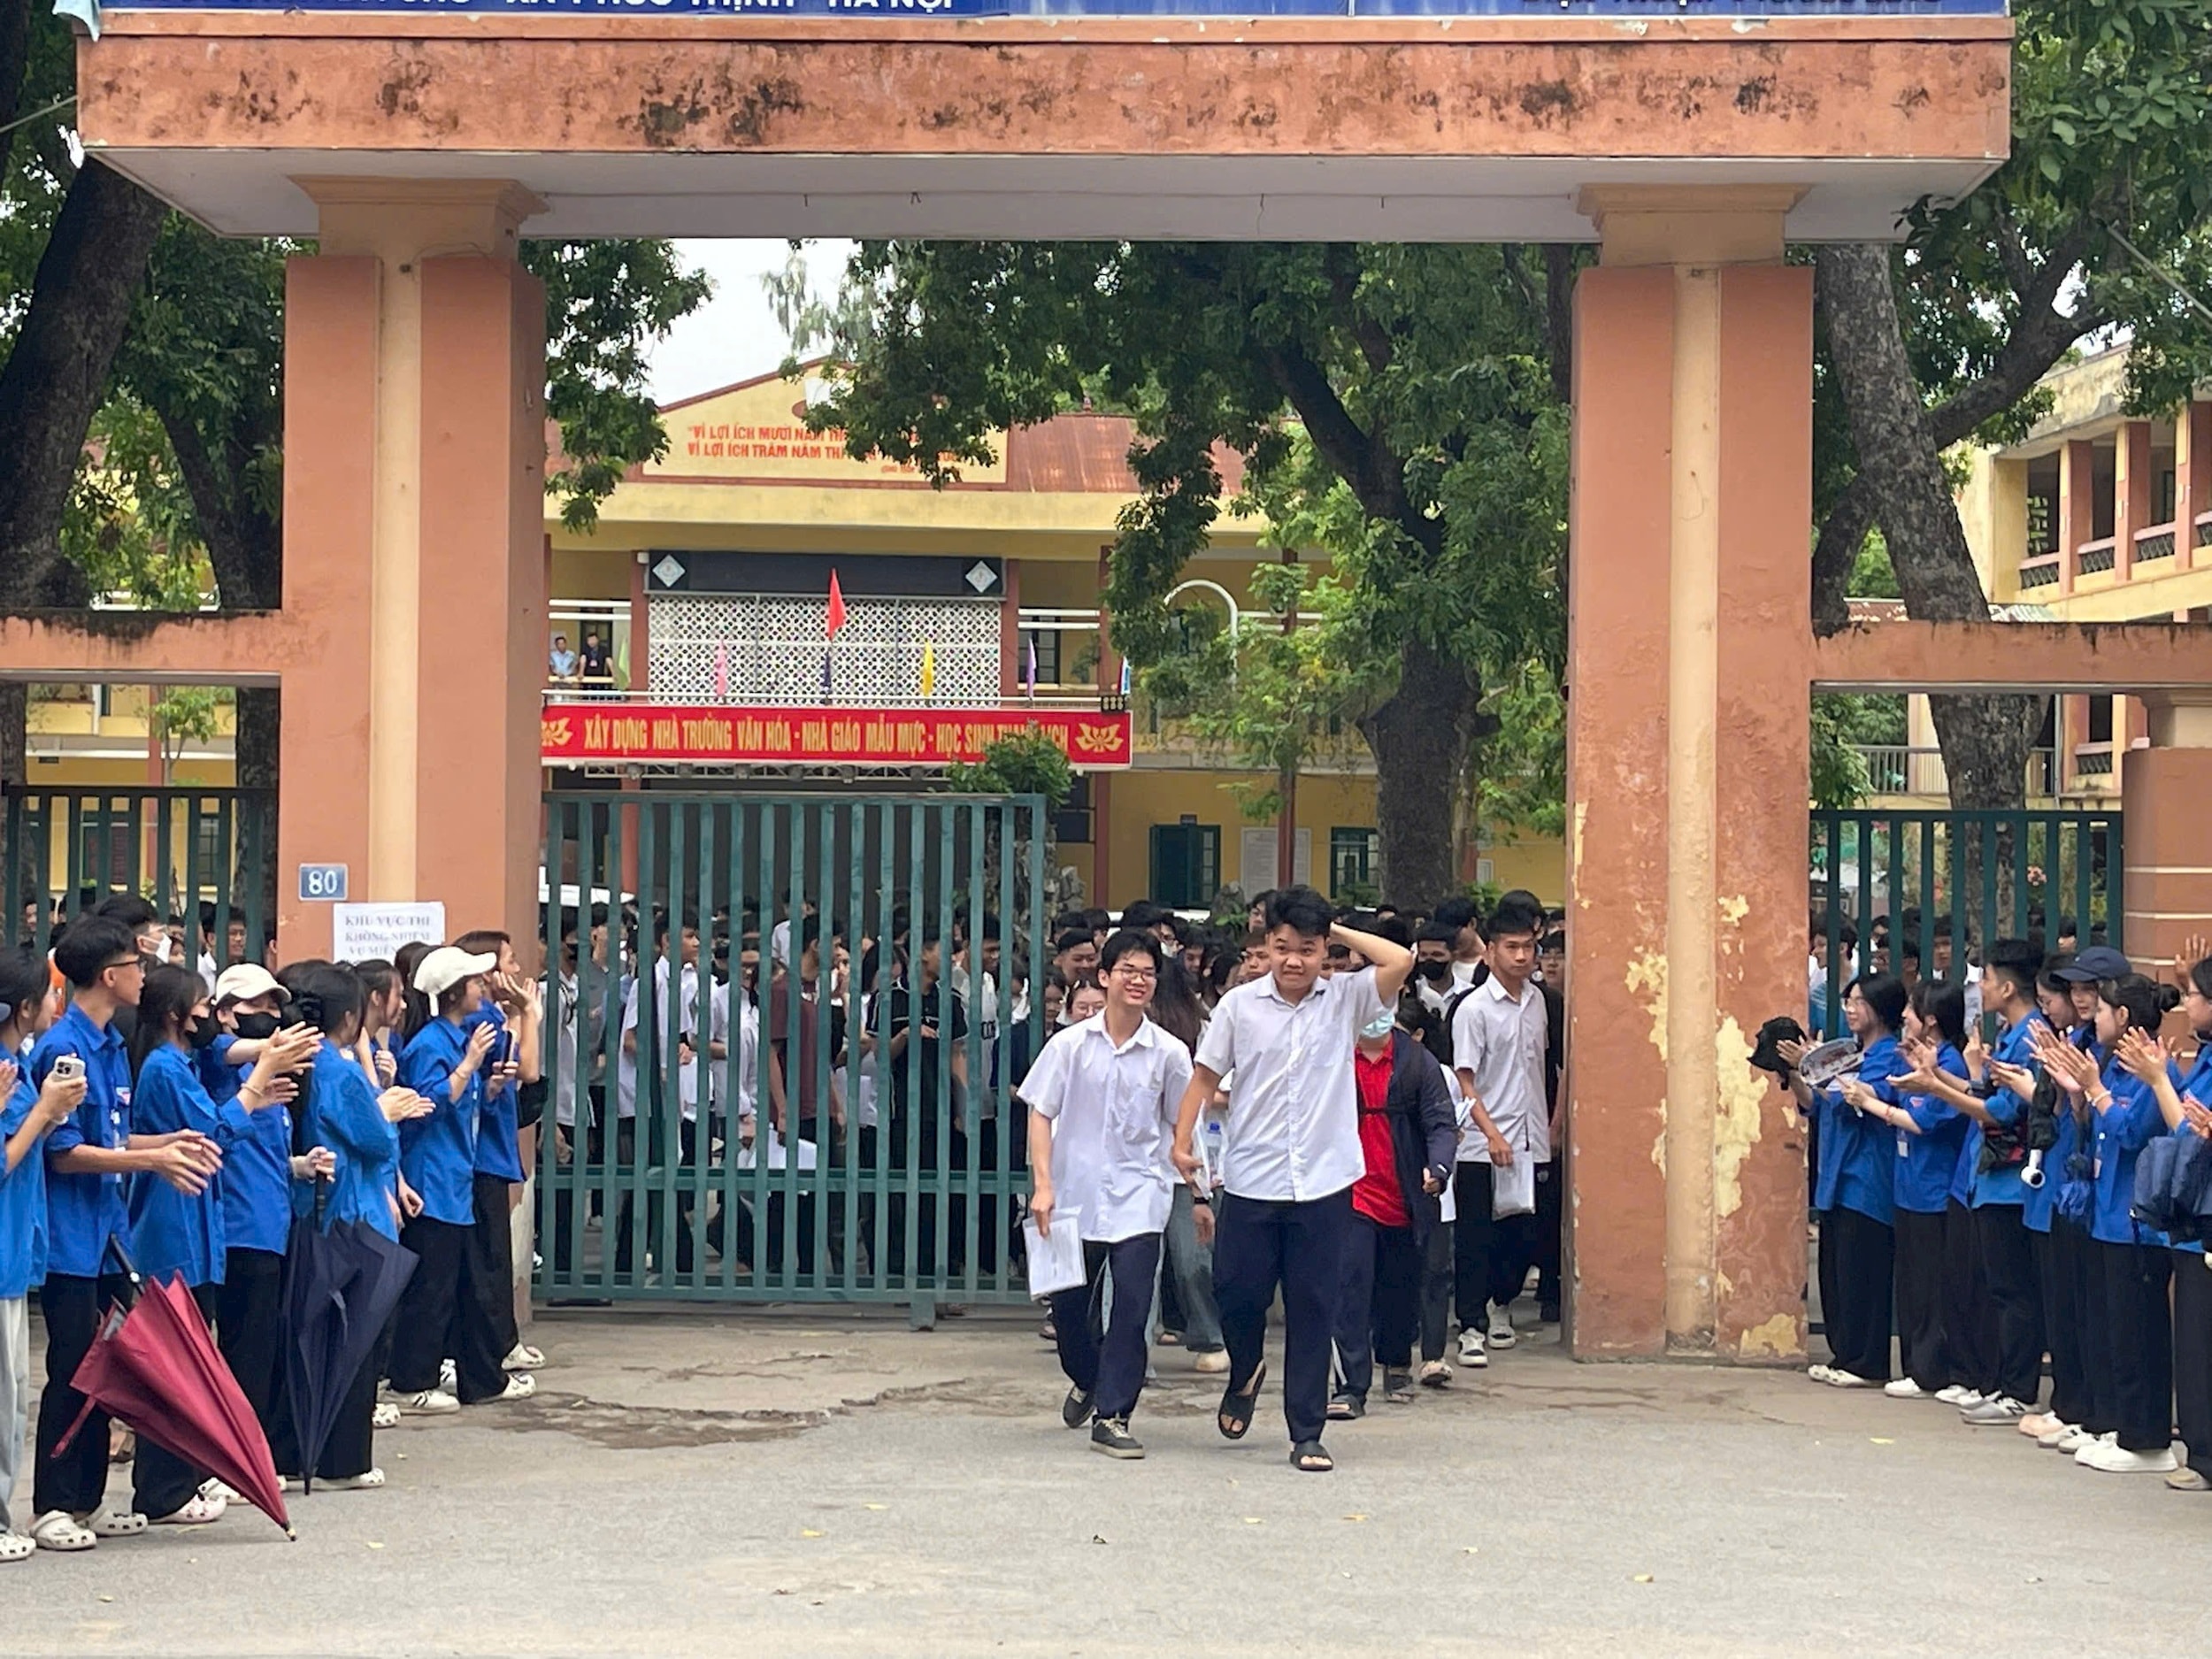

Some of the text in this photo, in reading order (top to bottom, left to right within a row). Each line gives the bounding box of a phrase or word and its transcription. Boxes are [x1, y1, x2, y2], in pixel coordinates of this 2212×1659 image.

[733, 421, 755, 440] ÍCH
[728, 440, 749, 457] ÍCH
[584, 713, 610, 750] XÂY
[612, 716, 648, 756] DỰNG
[652, 713, 680, 750] NHÀ
[682, 712, 733, 751] TRƯỜNG
[736, 715, 763, 751] VĂN
[765, 714, 791, 751] HÓA
[802, 716, 828, 752] NHÀ
[831, 716, 861, 752] GIÁO
[865, 713, 894, 752] MẪU
[897, 720, 926, 758] MỰC
[936, 723, 962, 758] HỌC
[309, 870, 338, 895] 80
